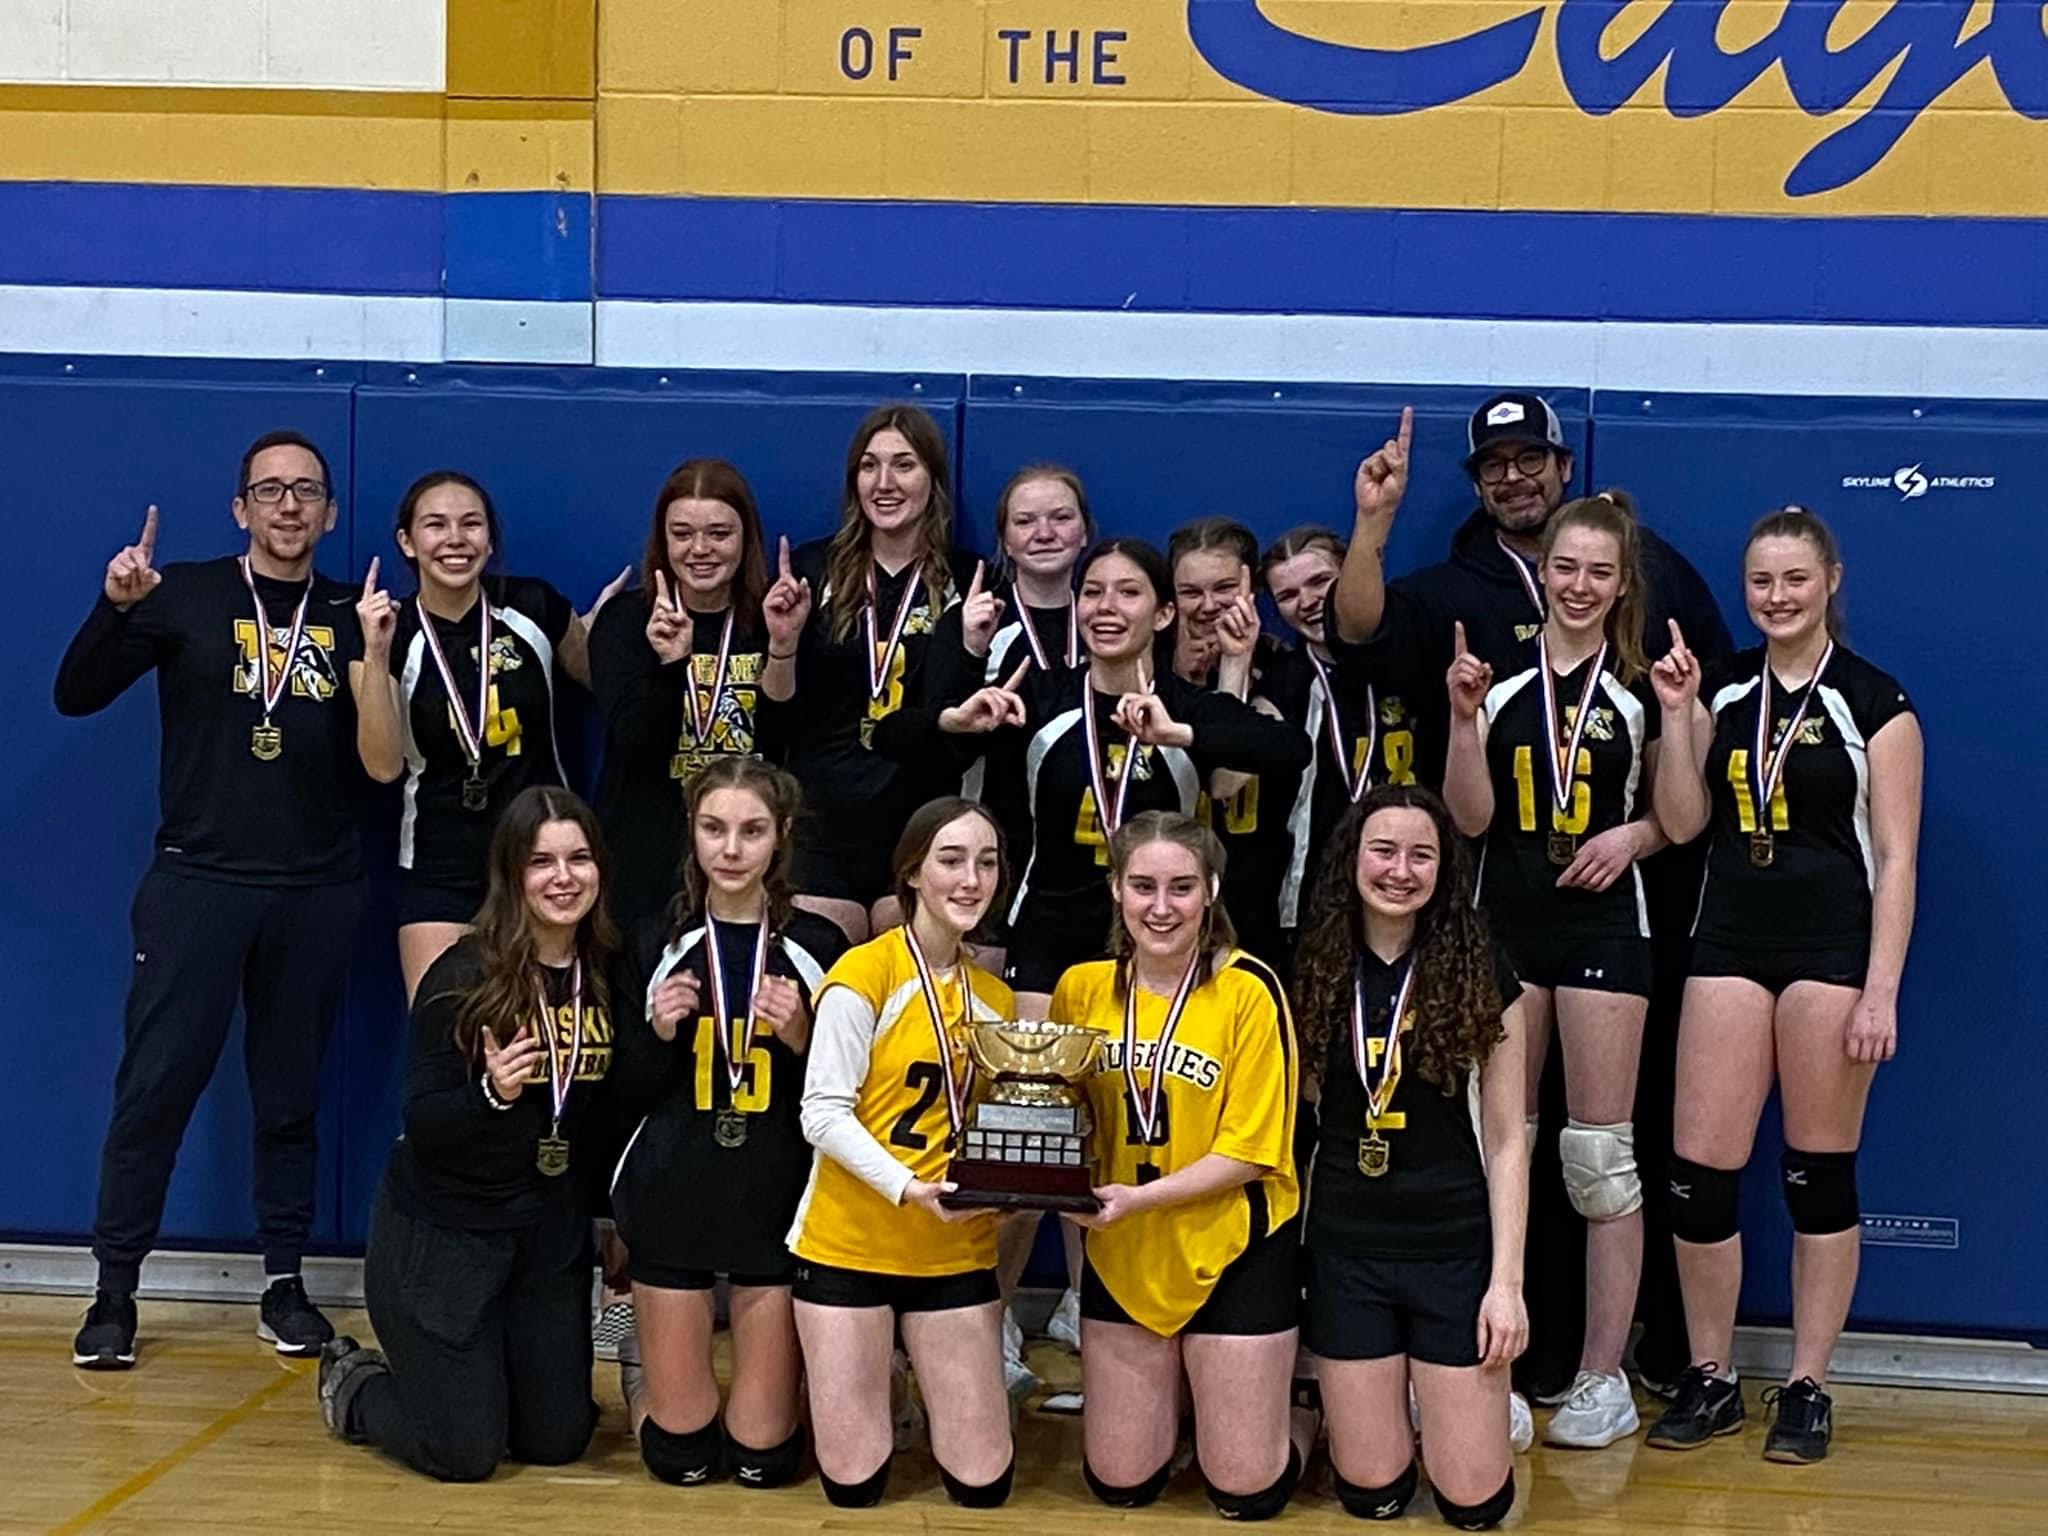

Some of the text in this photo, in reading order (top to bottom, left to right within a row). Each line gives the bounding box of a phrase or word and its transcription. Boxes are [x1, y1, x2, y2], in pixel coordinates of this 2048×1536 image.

[840, 27, 1127, 85] OF THE
[1930, 476, 1996, 489] ATHLETICS
[1512, 744, 1592, 835] 16
[1727, 748, 1790, 833] 11
[692, 1015, 772, 1114] 15
[889, 1060, 958, 1153] 2
